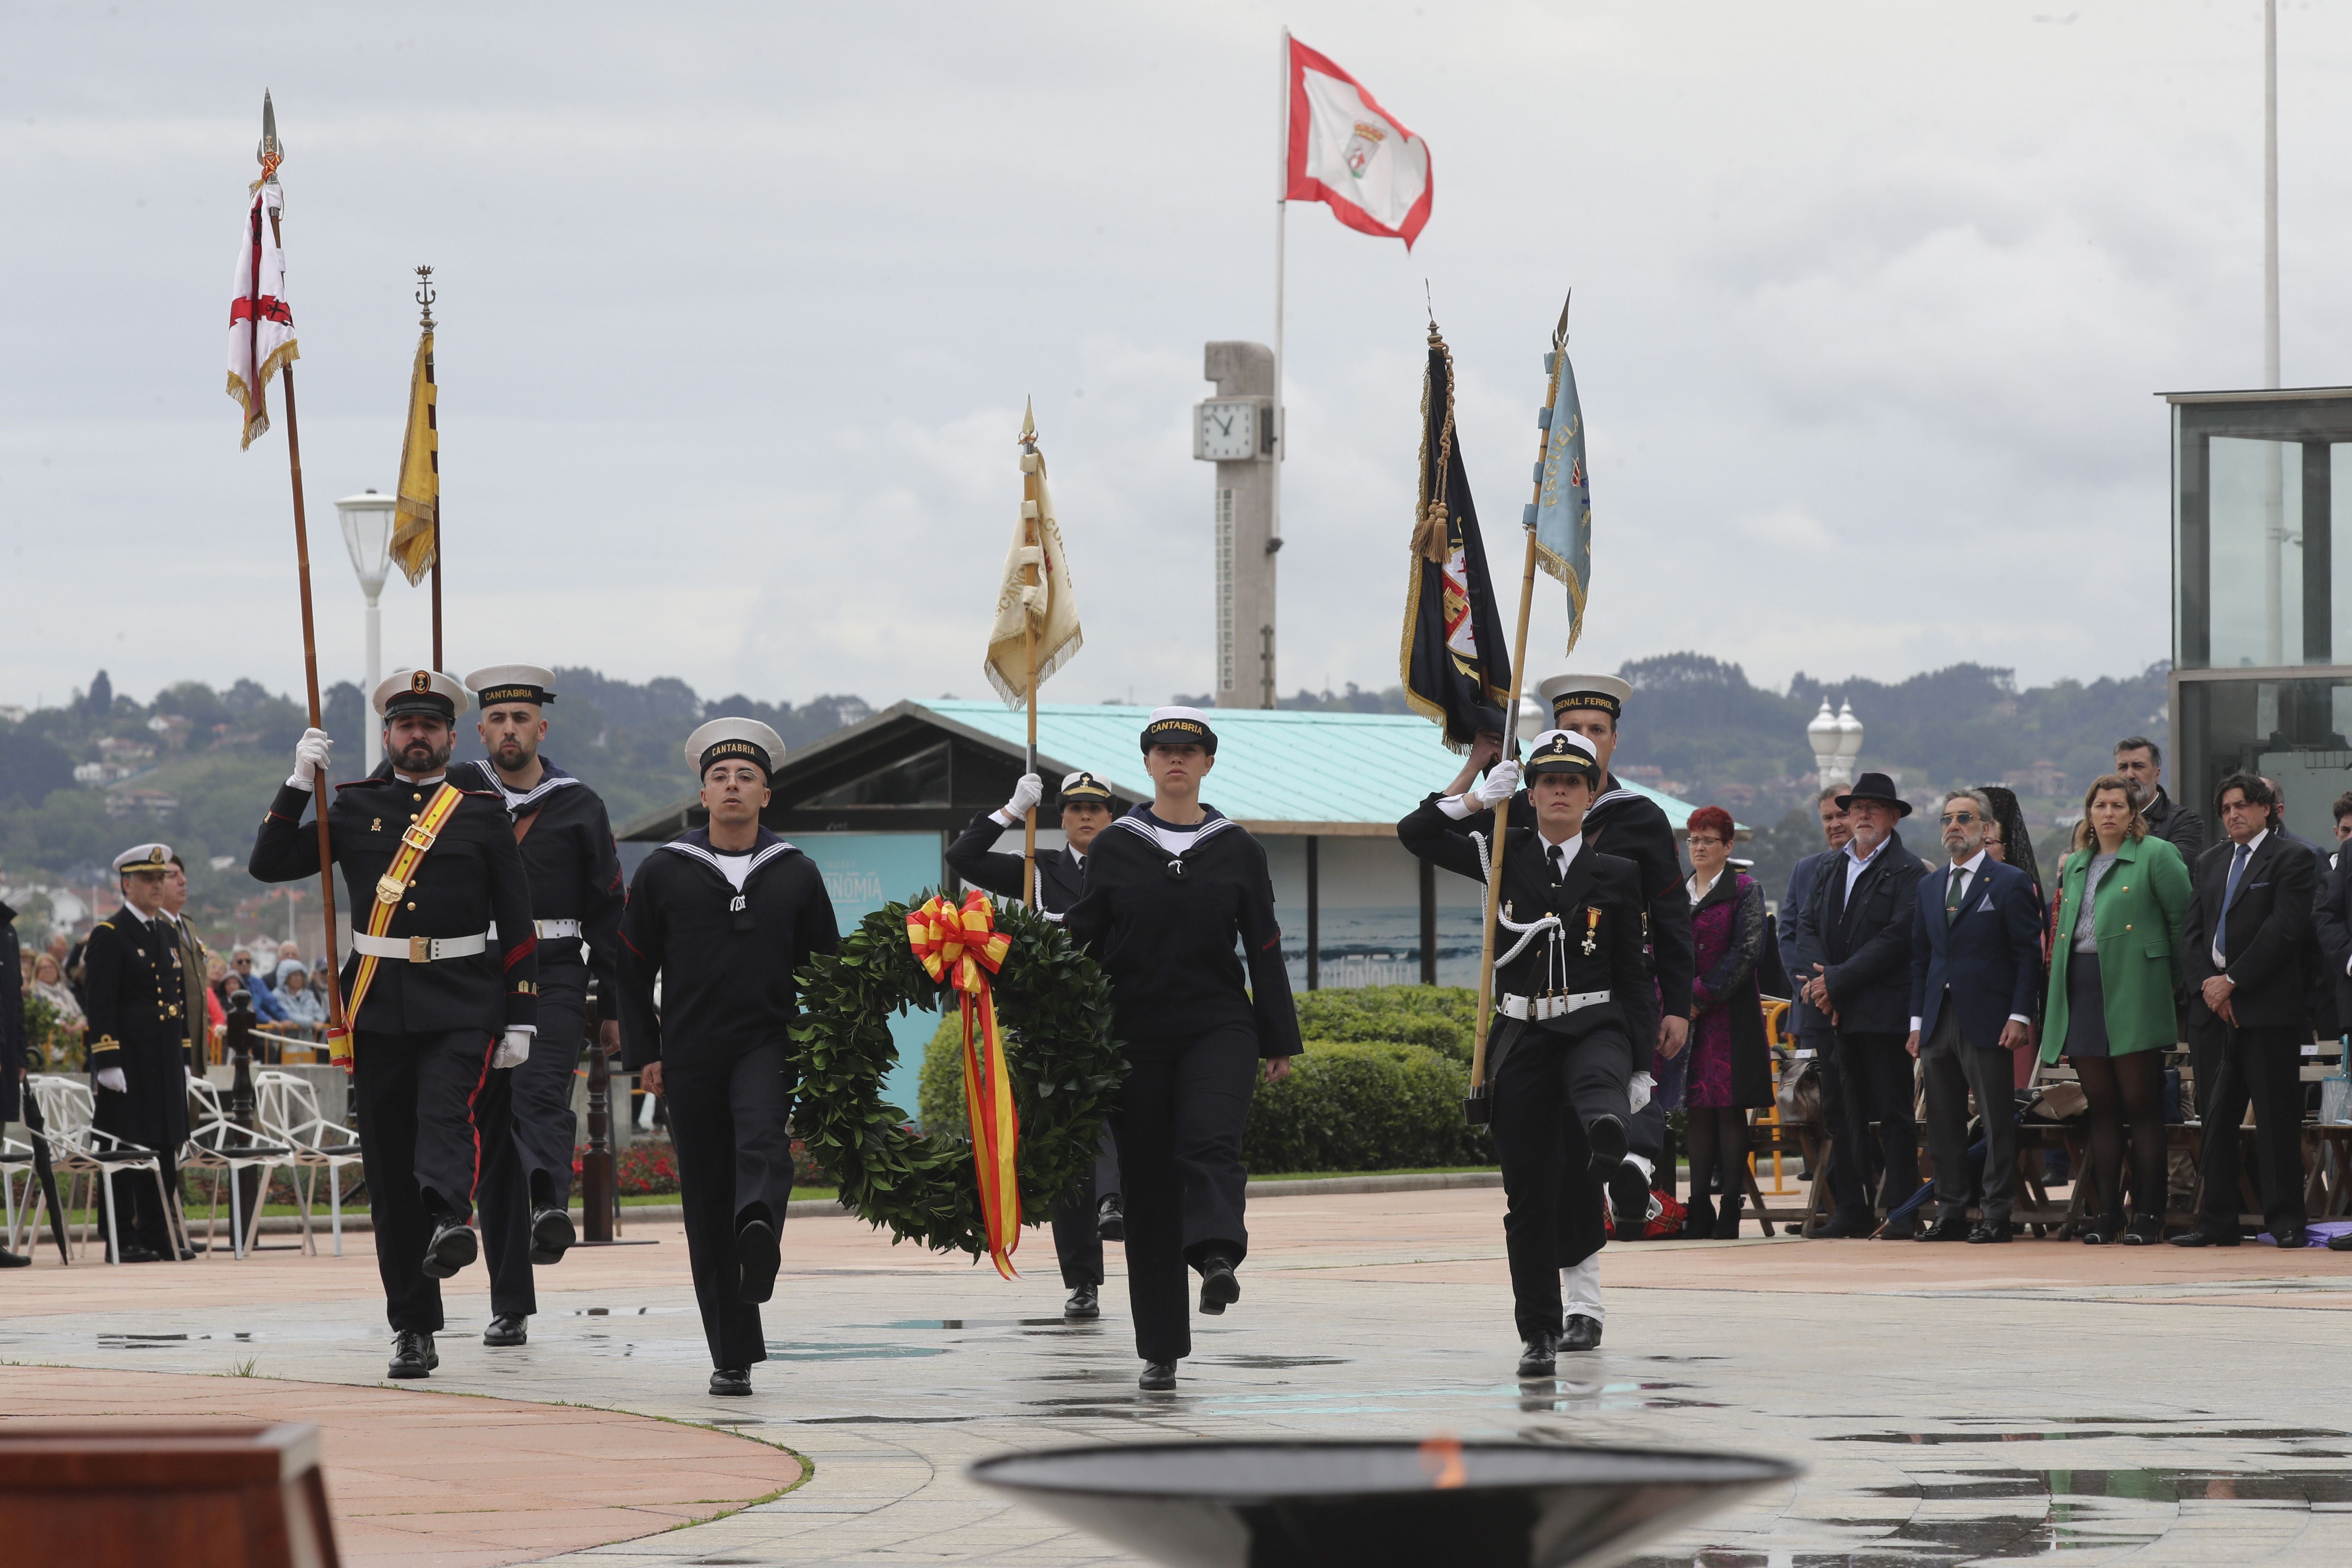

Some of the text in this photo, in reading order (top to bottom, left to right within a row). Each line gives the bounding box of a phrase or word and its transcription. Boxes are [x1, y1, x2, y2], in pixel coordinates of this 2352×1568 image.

[1545, 414, 1578, 507] ESCUELA
[485, 689, 532, 700] CANTABRIA
[1584, 697, 1613, 710] FERROL
[1152, 721, 1202, 735] CANTABRIA
[712, 744, 754, 756] CANTABRIA
